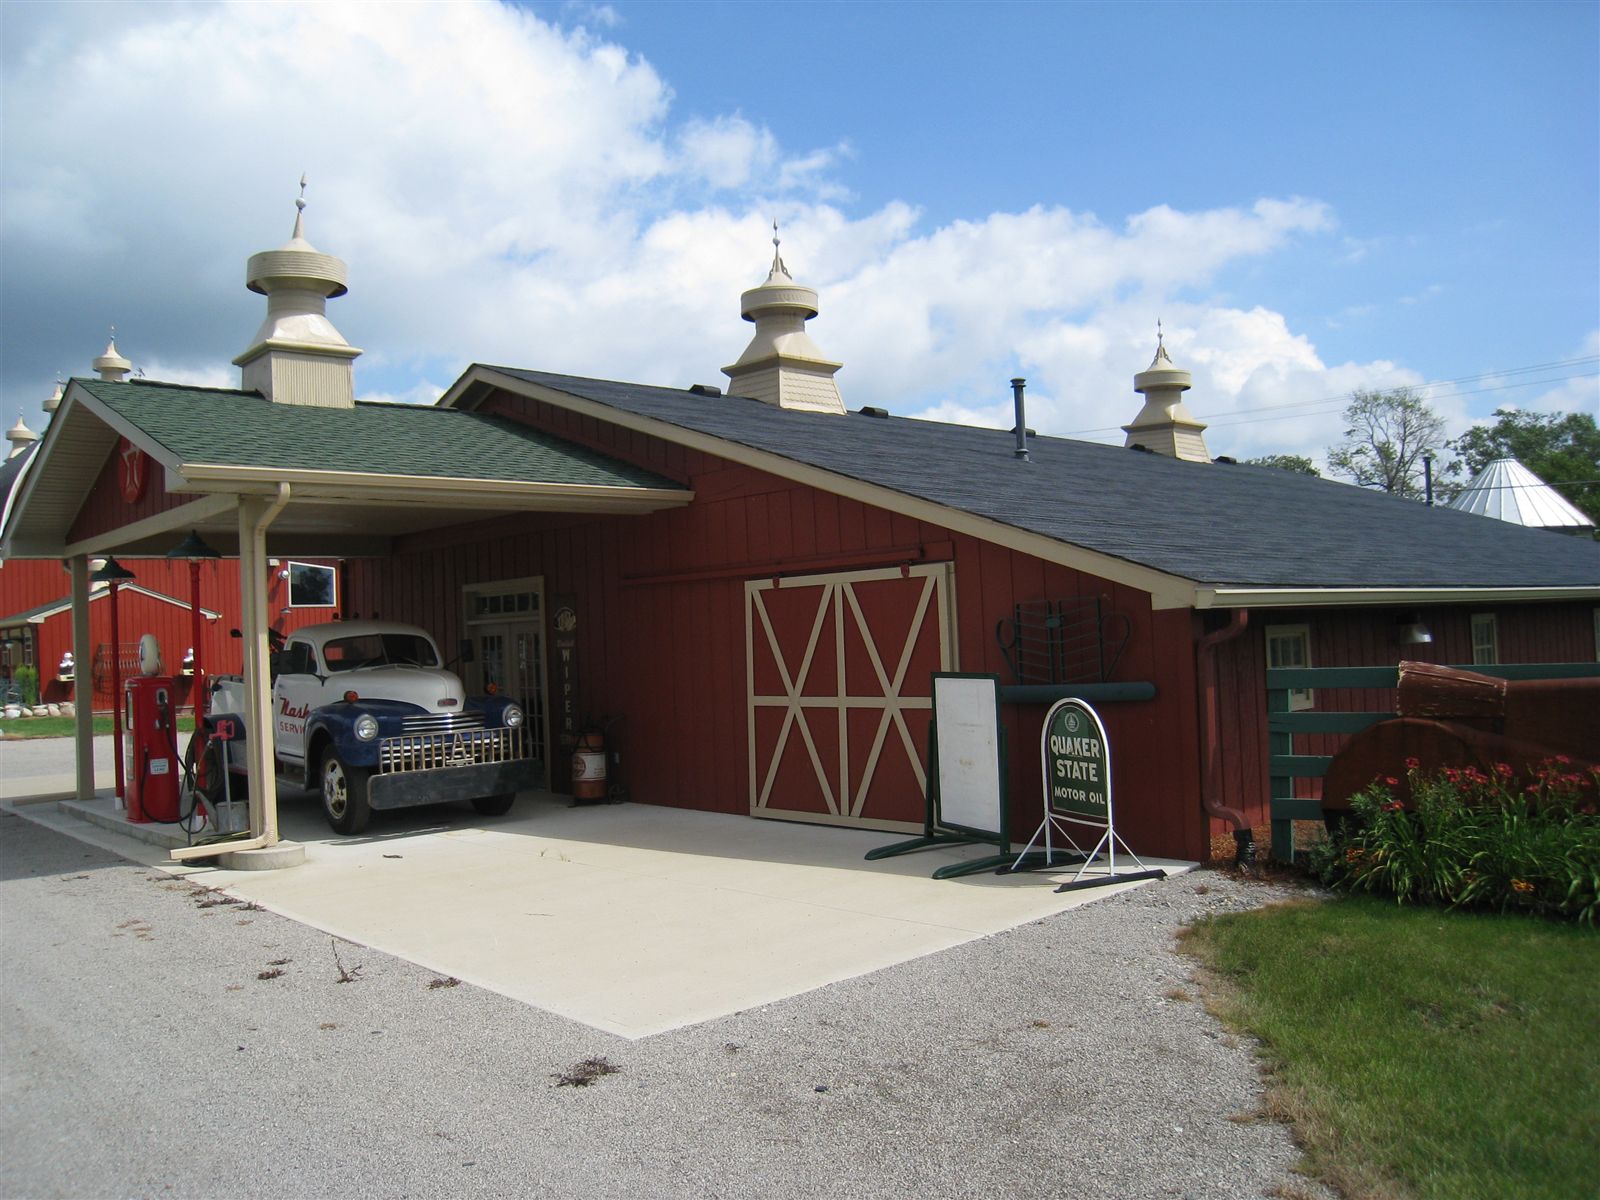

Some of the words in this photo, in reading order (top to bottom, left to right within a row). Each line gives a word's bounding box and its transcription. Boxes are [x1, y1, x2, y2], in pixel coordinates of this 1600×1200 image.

[562, 648, 573, 730] WIPER
[280, 721, 304, 734] SERVI
[1050, 735, 1100, 757] QUAKER
[1056, 759, 1098, 782] STATE
[1054, 786, 1086, 802] MOTOR
[1089, 791, 1105, 805] OIL
